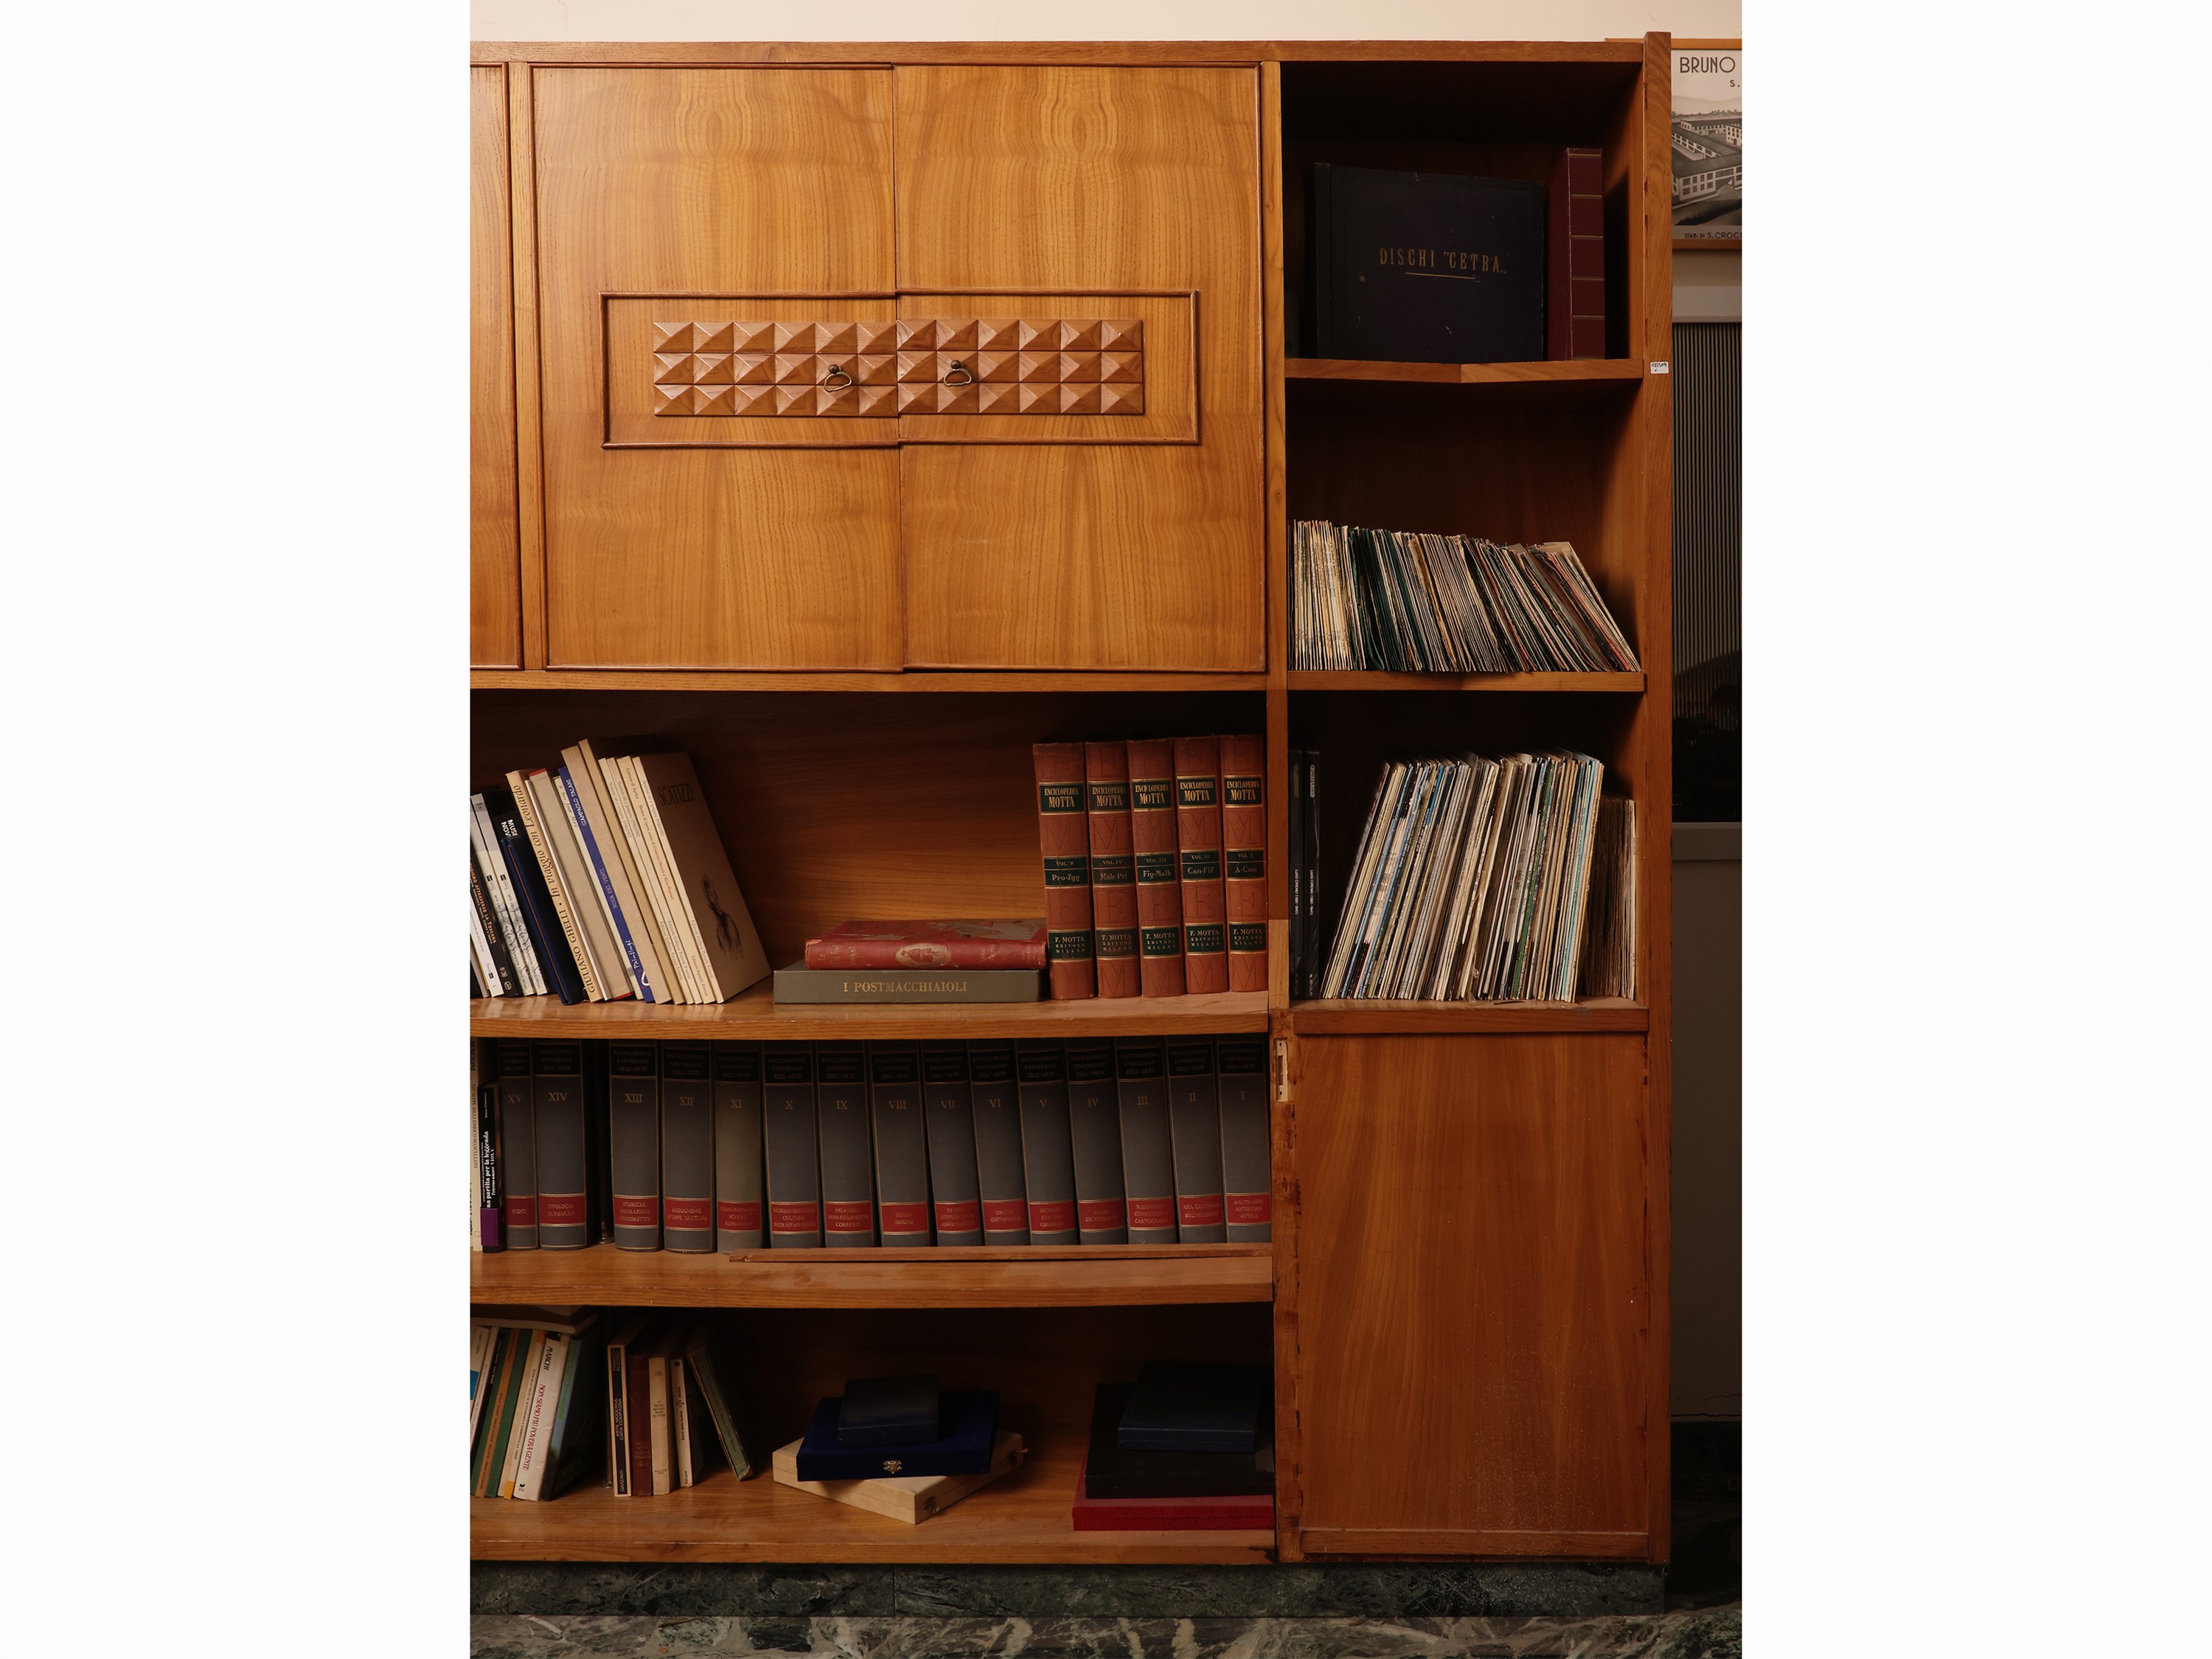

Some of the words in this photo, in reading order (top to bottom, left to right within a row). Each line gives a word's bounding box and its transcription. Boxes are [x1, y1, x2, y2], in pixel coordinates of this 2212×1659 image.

[1680, 57, 1735, 73] BRUNO
[1380, 248, 1434, 267] DISCHI
[565, 778, 576, 797] TALANI
[1092, 786, 1126, 794] ENCICLOPEDIA
[1135, 785, 1169, 793] ENCICLOPEDIA
[1180, 781, 1214, 790] ENCICLOPEDIA
[1227, 780, 1259, 789] ENCICLOPEDIA
[657, 782, 696, 806] SCATIZZI
[1044, 787, 1079, 796] ENCICLOPEDIA
[1184, 790, 1210, 801] MOTTA
[1231, 789, 1256, 801] MOTTA
[1048, 796, 1075, 807] MOTTA
[1096, 795, 1122, 807] MOTTA
[1139, 793, 1165, 804] MOTTA
[510, 784, 535, 830] Leonardo
[572, 797, 587, 827] GIAMPAOLO
[529, 830, 541, 847] con
[535, 848, 557, 884] viaggio
[549, 887, 560, 899] In
[474, 883, 487, 912] ATTRAVERSO
[486, 920, 498, 943] TOSCANA
[558, 909, 577, 943] GHELLI
[625, 938, 641, 969] Paintings
[572, 945, 595, 993] GIULIANO
[843, 982, 848, 992] I
[854, 981, 967, 992] POSTMACCHIAIOLI
[508, 1094, 523, 1103] XV
[549, 1092, 567, 1102] XIV
[625, 1093, 643, 1103] XIII
[1138, 1096, 1148, 1105] III
[1189, 1093, 1197, 1102] II
[1241, 1091, 1245, 1100] I
[679, 1097, 694, 1106] XII
[731, 1099, 742, 1108] XI
[785, 1100, 793, 1110] X
[836, 1100, 848, 1110] IX
[888, 1100, 906, 1109] VIII
[940, 1099, 956, 1109] VII
[989, 1099, 1002, 1108] VI
[1040, 1099, 1047, 1108] V
[1088, 1097, 1099, 1107] IV
[543, 1346, 554, 1370] MARCHI
[537, 1383, 546, 1397] NON
[532, 1397, 543, 1416] SIAMO
[531, 1416, 540, 1427] PIÙ
[526, 1427, 537, 1450] POVERA
[522, 1450, 532, 1470] GENTE
